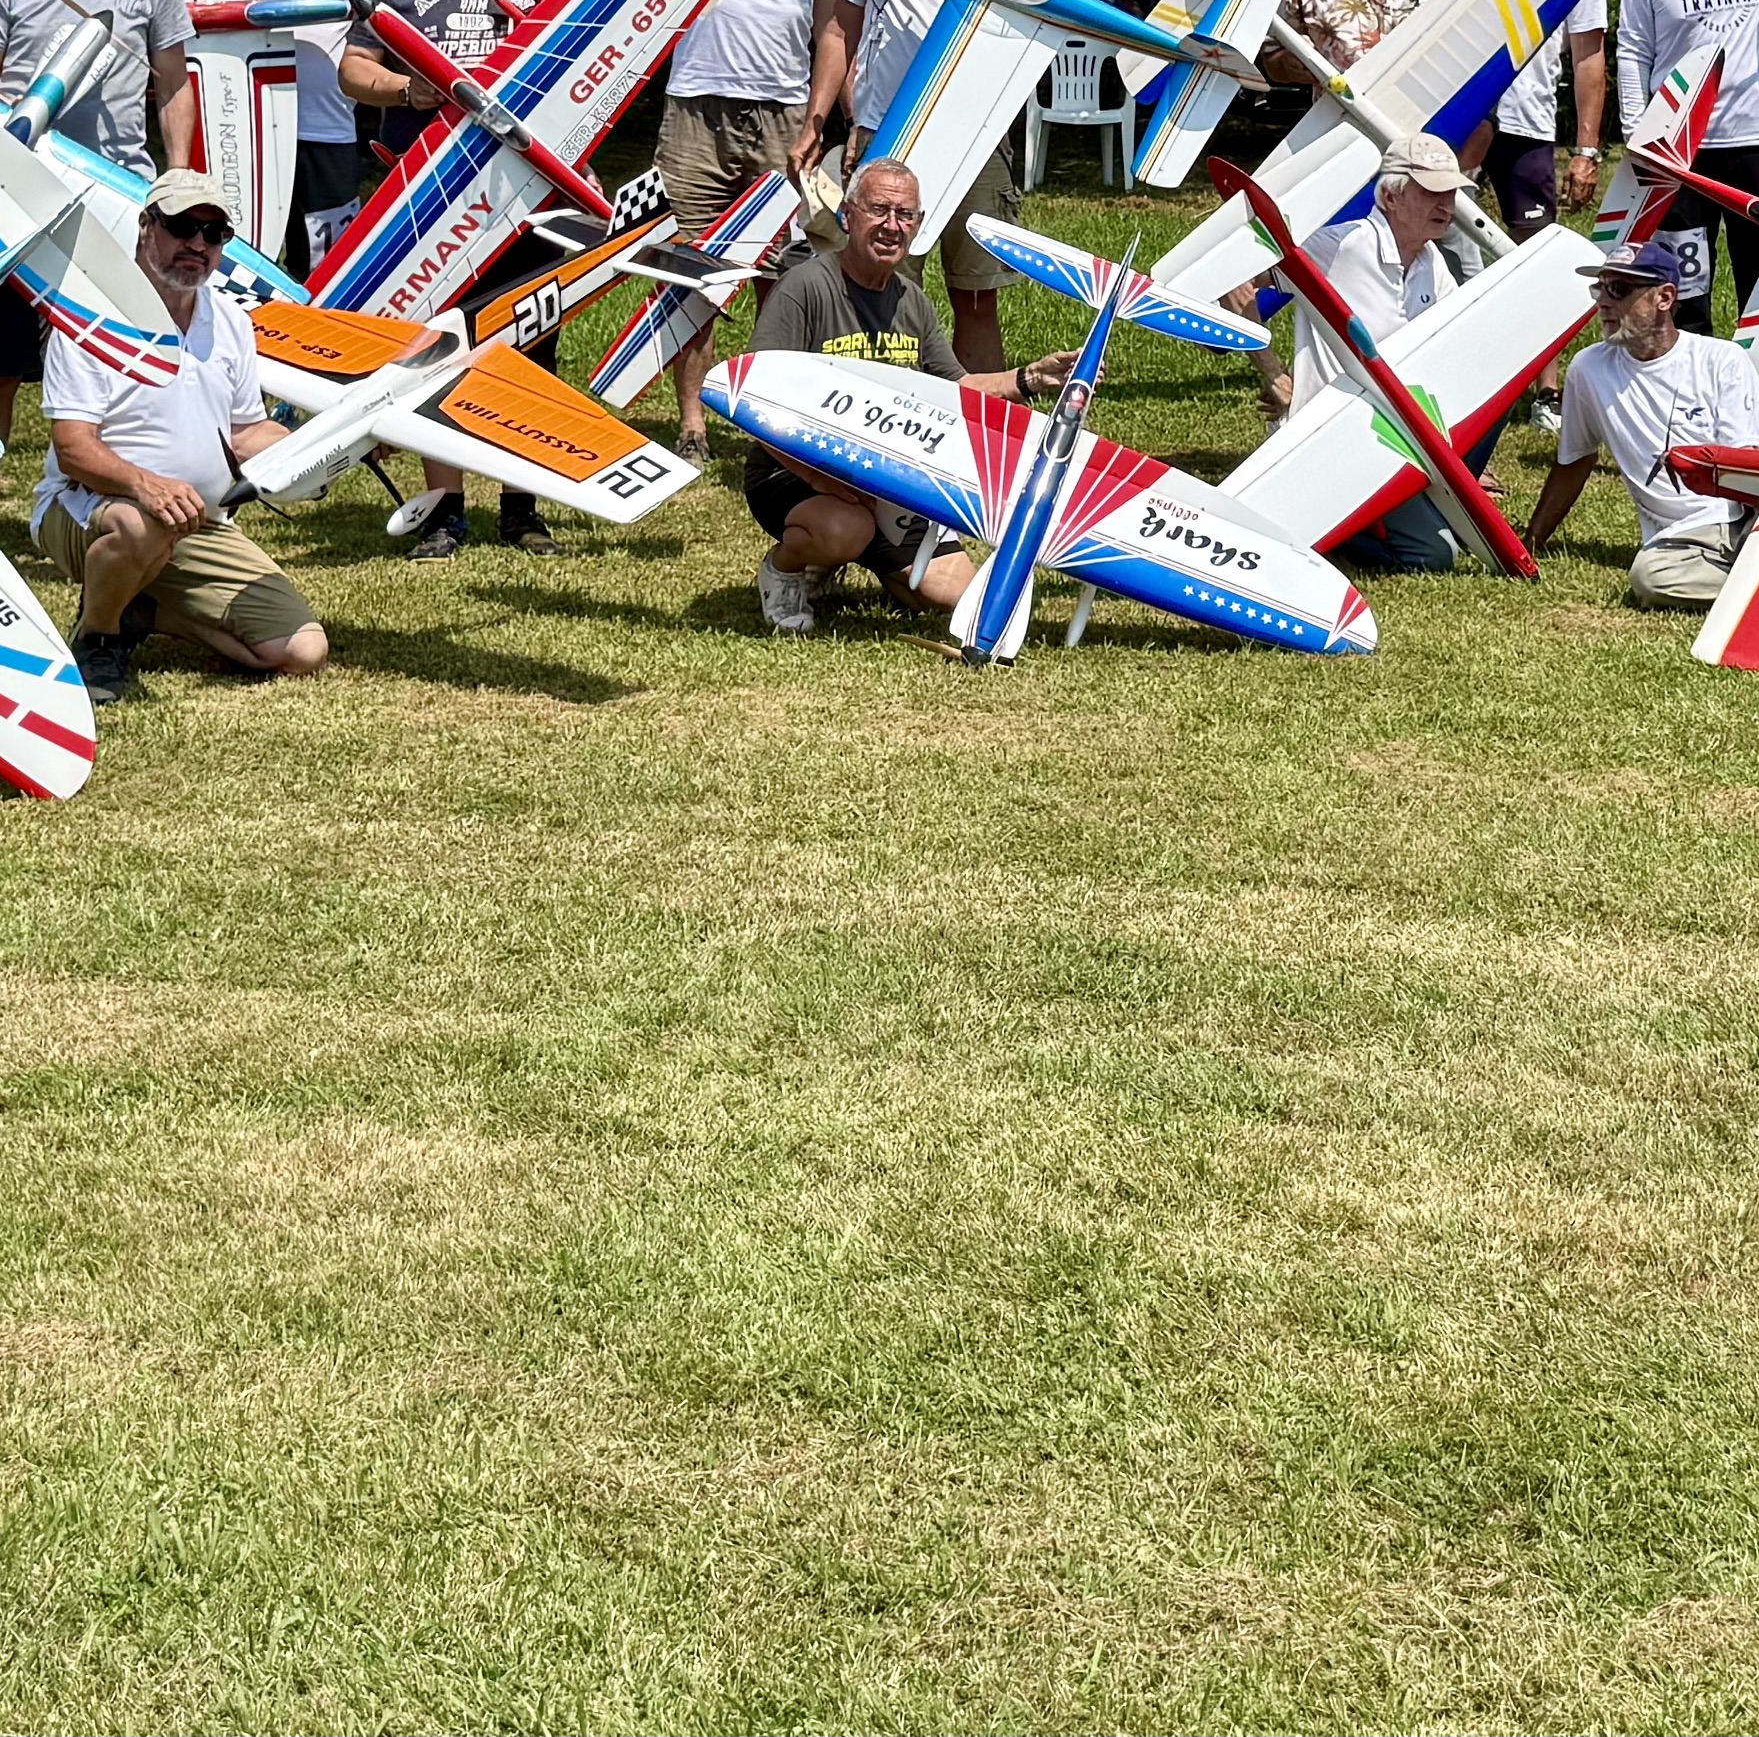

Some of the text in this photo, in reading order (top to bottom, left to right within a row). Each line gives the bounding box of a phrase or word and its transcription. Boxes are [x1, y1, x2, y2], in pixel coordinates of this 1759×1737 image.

[445, 29, 481, 40] VINTAGE
[569, 44, 626, 105] GER
[513, 279, 562, 348] 20
[497, 418, 600, 462] CASSUTT
[596, 454, 672, 500] 20
